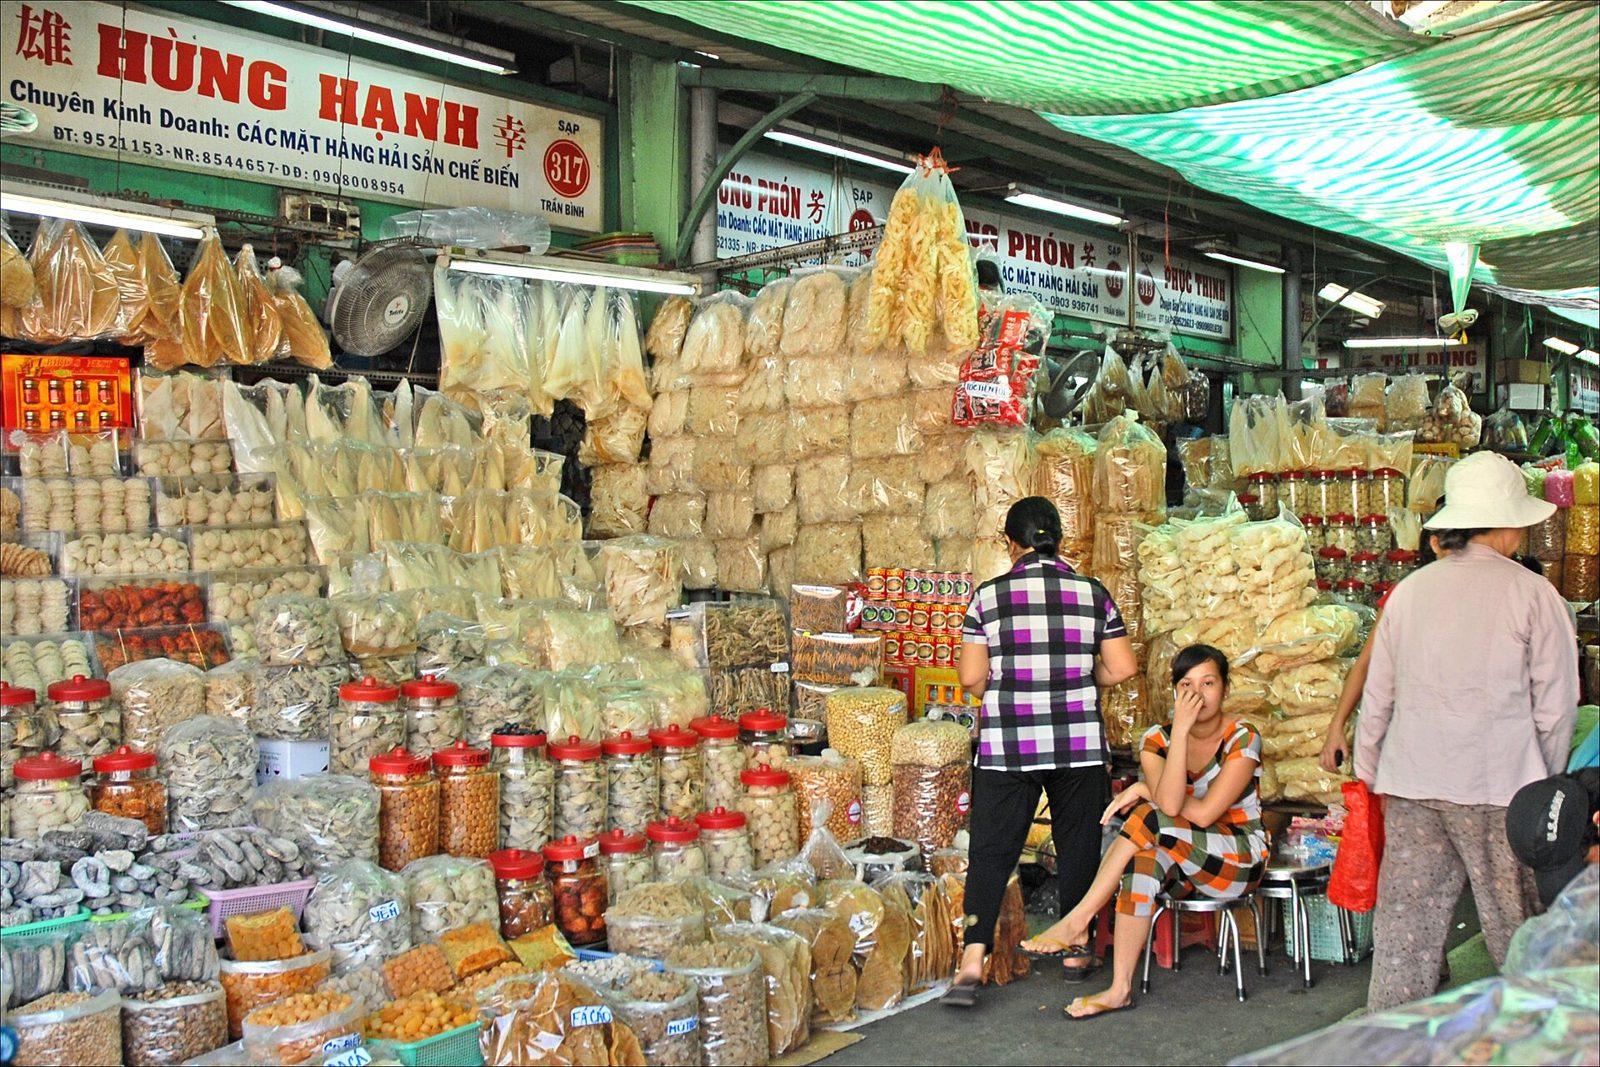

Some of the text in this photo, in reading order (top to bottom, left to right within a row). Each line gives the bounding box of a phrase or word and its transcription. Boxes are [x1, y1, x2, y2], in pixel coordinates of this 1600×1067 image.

[15, 4, 73, 66] 雄
[97, 23, 479, 150] HÙNG HẠNH
[10, 79, 95, 115] Chuyên
[103, 98, 151, 125] Kinh
[160, 108, 229, 139] Doanh:
[326, 134, 374, 165] HÀNG
[379, 142, 408, 170] HẢI
[411, 149, 445, 175] SẢN
[448, 159, 480, 182] CHẾ
[484, 163, 520, 189] BIẾN
[492, 114, 527, 159] 幸
[558, 119, 580, 135] SẠP
[550, 151, 584, 192] 317
[564, 198, 585, 218] BÌNH
[852, 187, 873, 205] SẠP
[753, 214, 767, 236] CÁC
[768, 218, 782, 244] MẶT
[784, 218, 802, 243] HÀNG
[1007, 232, 1075, 270] PHÓN
[1016, 265, 1036, 291] MẶT
[1038, 272, 1063, 293] HÀNG
[1065, 275, 1080, 296] HẢI
[1071, 301, 1099, 315] 936741
